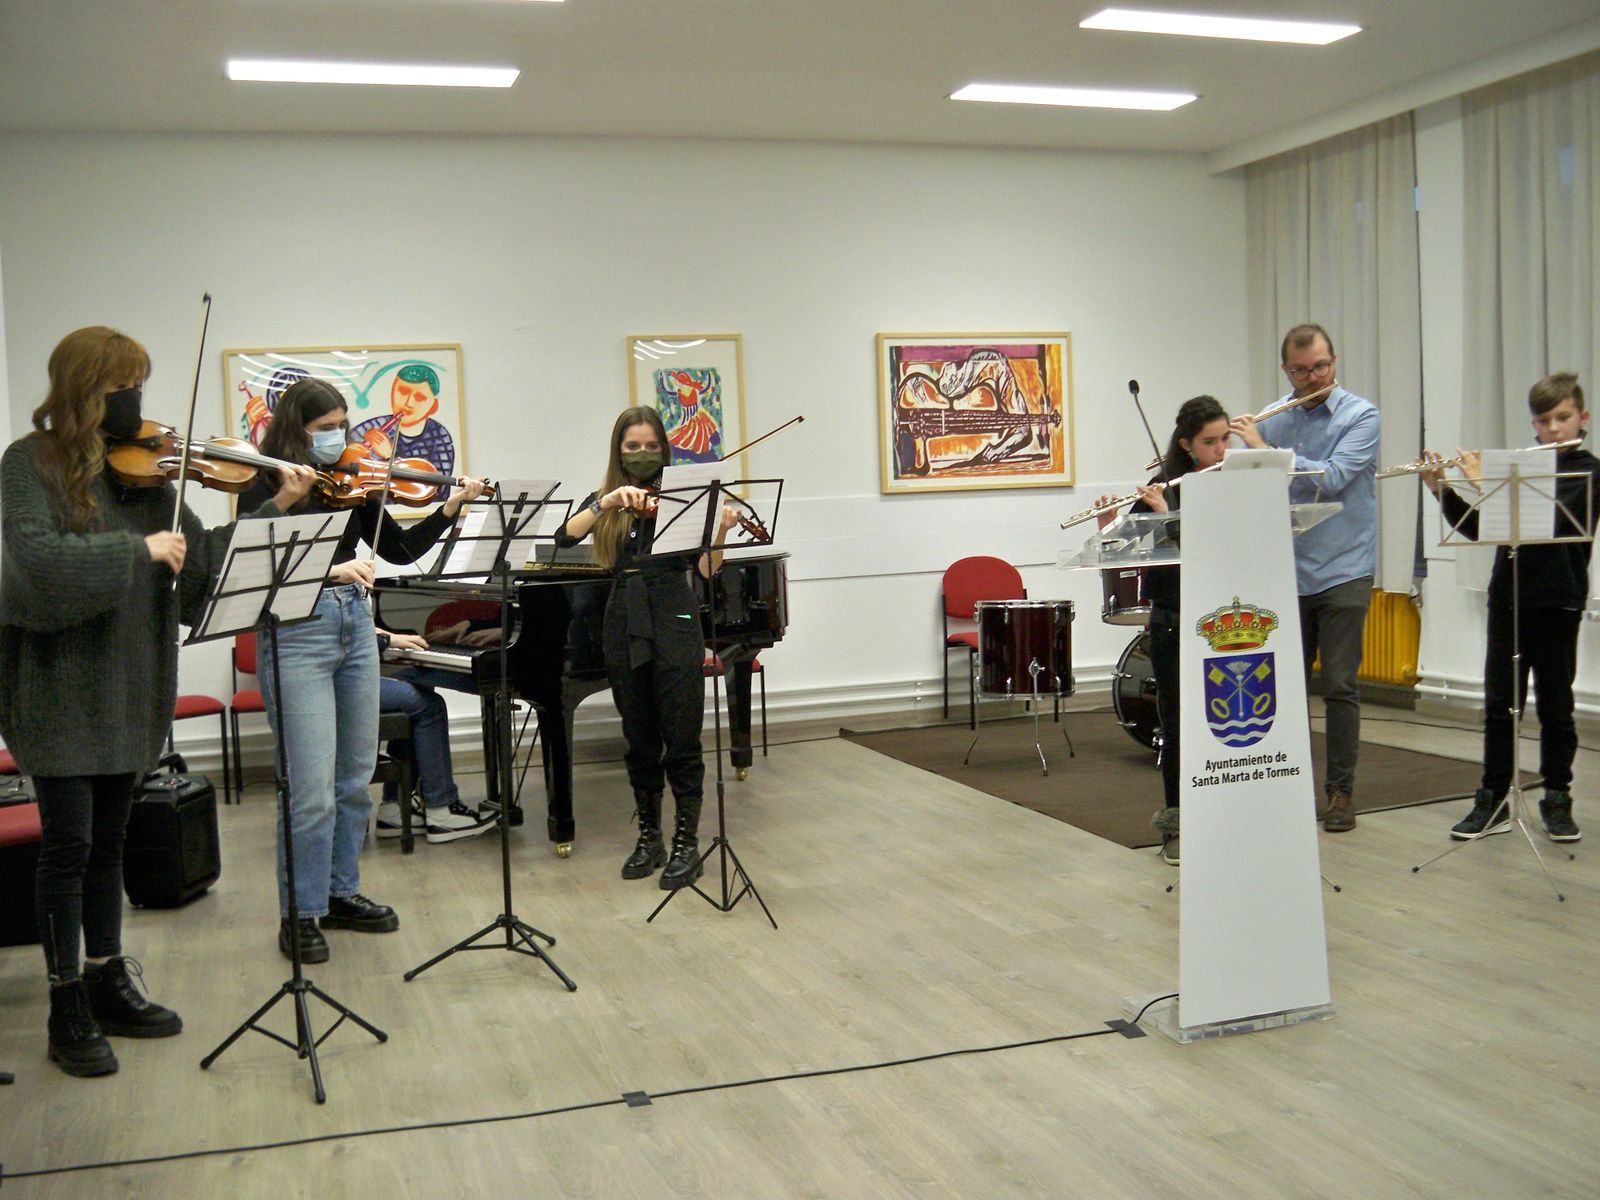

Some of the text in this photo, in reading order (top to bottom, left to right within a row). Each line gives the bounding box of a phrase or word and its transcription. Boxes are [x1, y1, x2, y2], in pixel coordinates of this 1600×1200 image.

[1205, 751, 1287, 772] Ayuntamiento de
[1192, 766, 1300, 788] Santa Marta de Tormes
